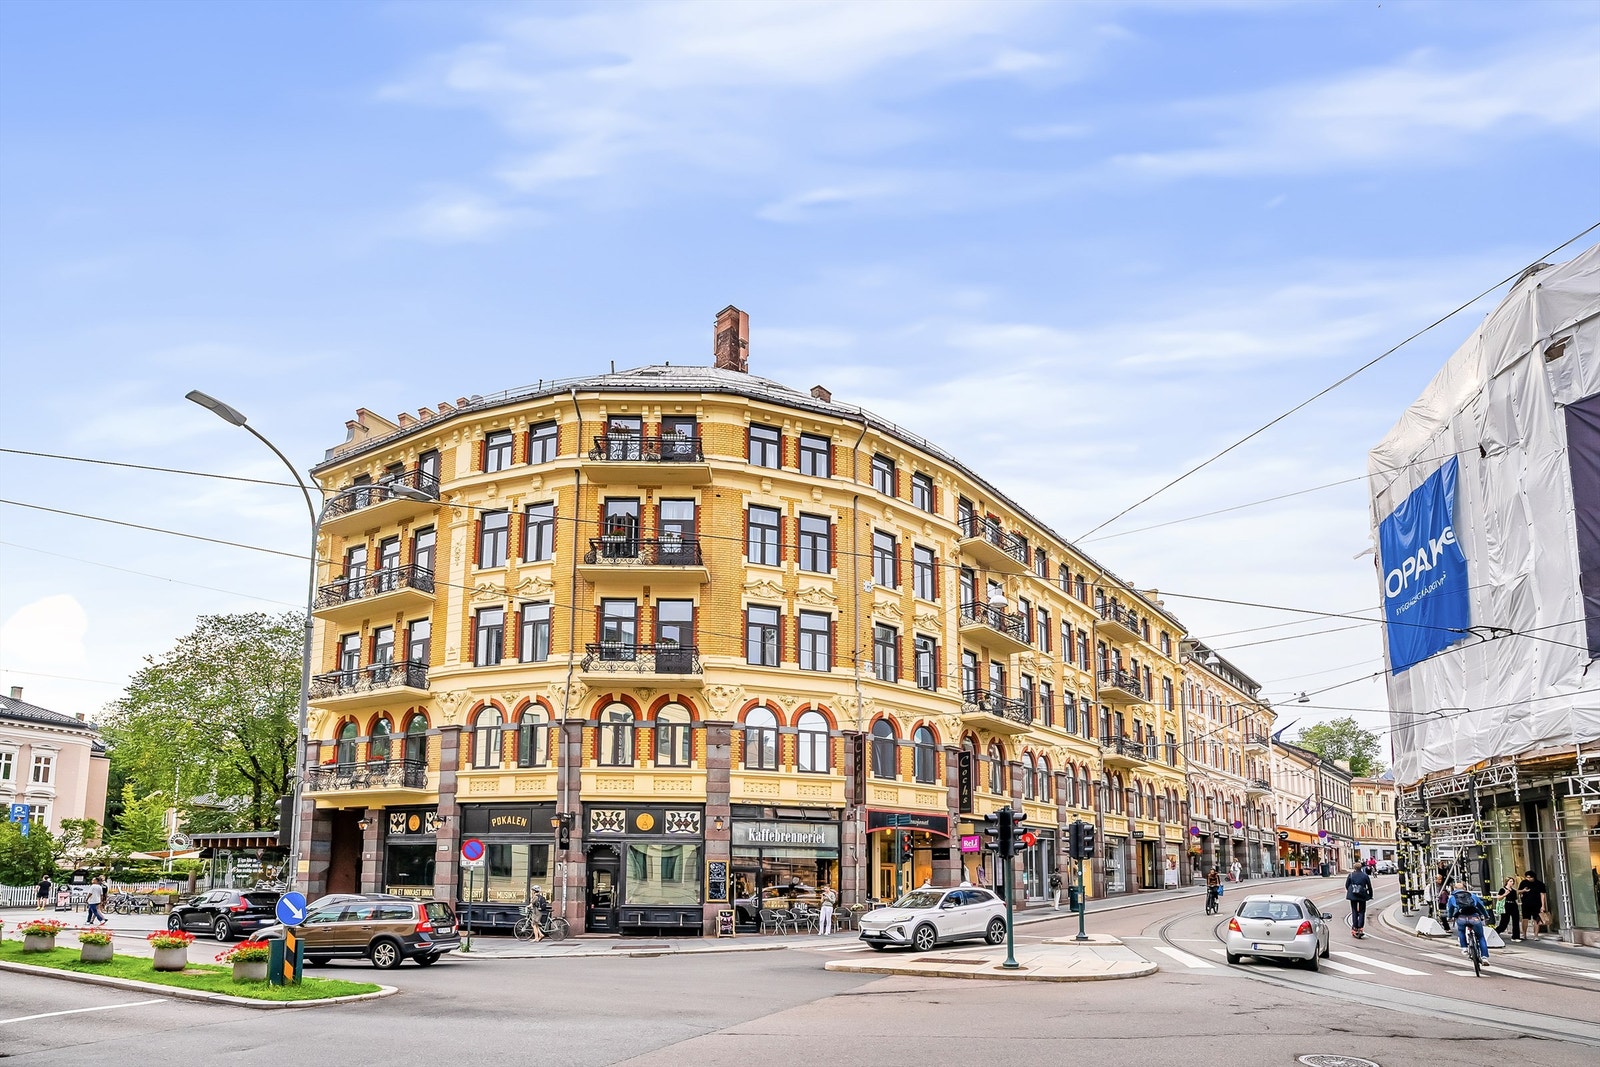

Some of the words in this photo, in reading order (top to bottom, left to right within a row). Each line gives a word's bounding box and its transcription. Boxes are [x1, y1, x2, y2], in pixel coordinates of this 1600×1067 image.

[959, 755, 969, 805] Cochs
[491, 815, 527, 827] POKALEN
[748, 827, 826, 844] Kaffebrenneriet
[464, 890, 482, 899] SORT
